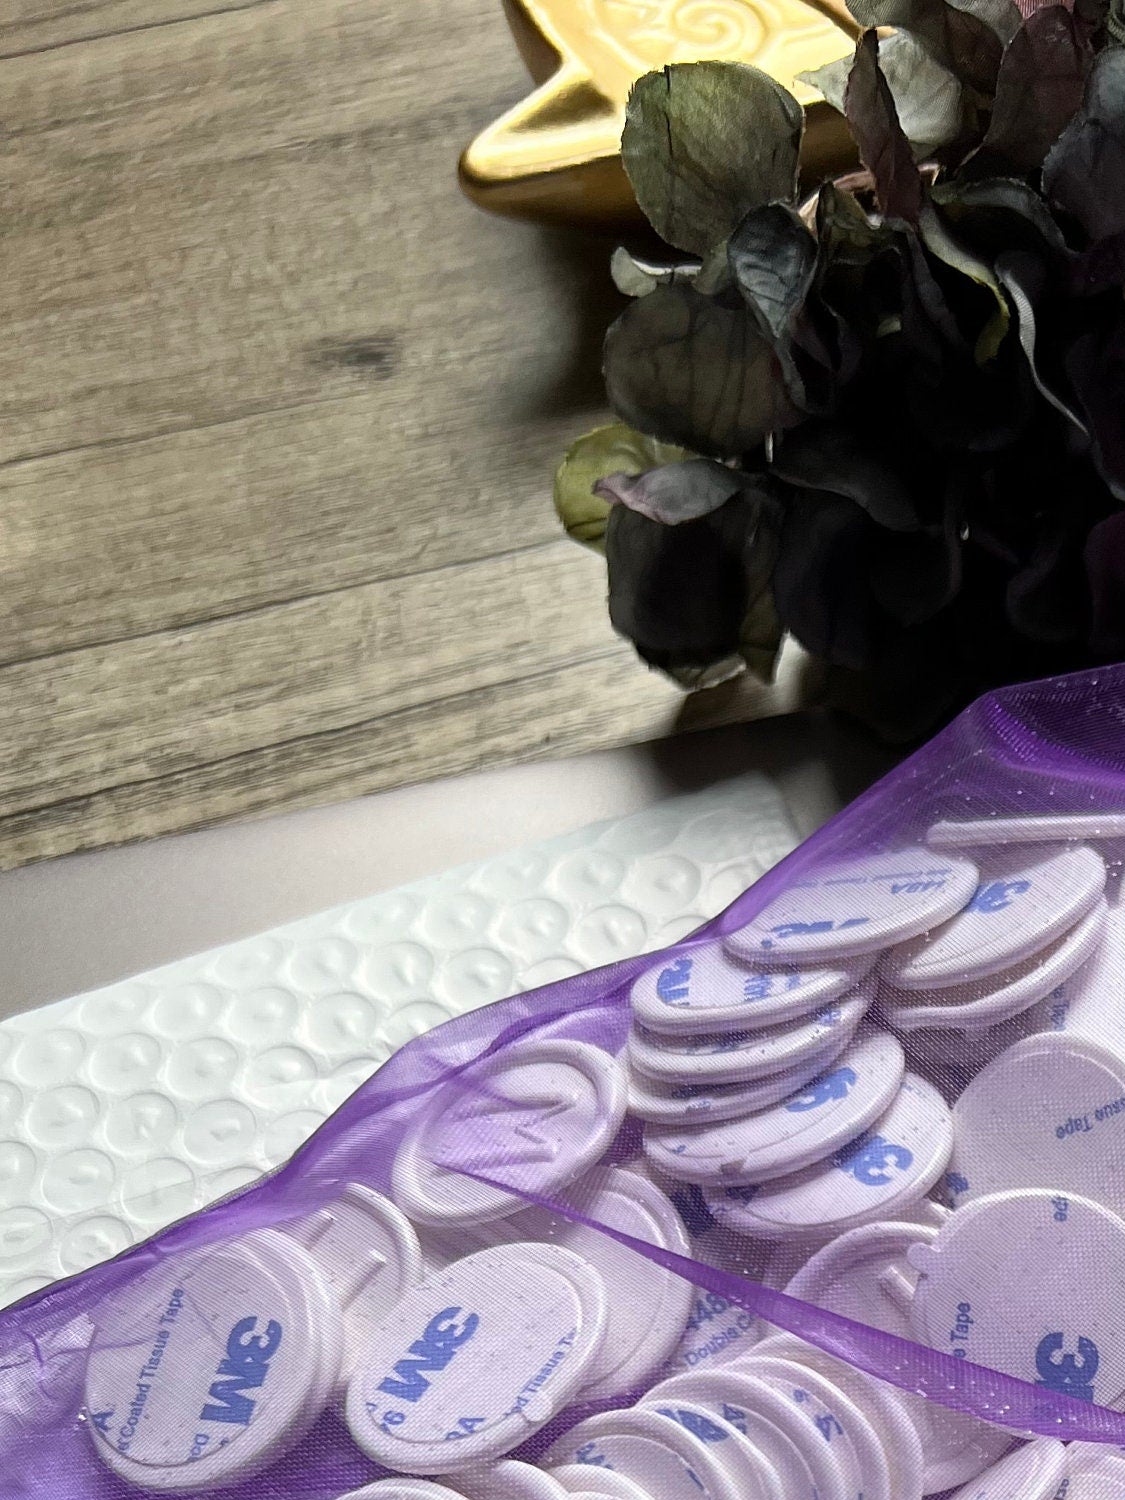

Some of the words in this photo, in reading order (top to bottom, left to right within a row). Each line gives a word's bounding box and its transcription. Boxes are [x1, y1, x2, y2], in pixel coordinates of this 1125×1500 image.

[139, 1329, 170, 1381] Tissue
[159, 1287, 184, 1325] Tape
[200, 1315, 283, 1427] 3M
[376, 1305, 480, 1403] 3M
[950, 1301, 972, 1353] Tape
